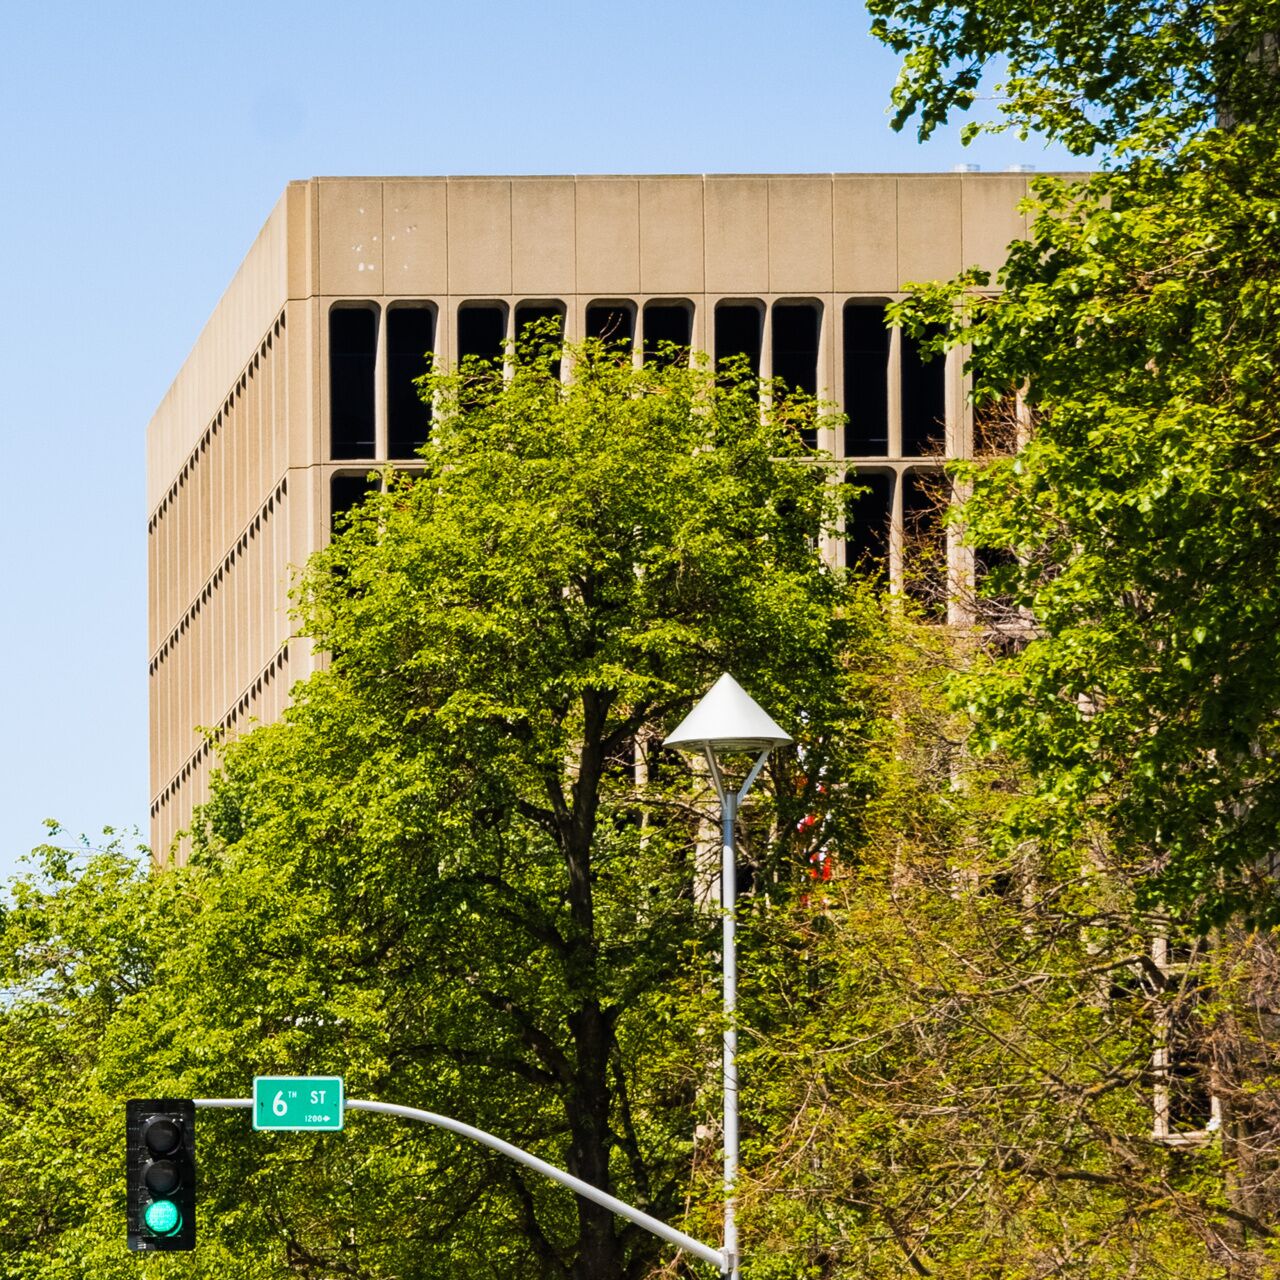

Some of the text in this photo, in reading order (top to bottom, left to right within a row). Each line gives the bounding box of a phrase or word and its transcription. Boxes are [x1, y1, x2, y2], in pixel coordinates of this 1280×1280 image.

[272, 1090, 326, 1117] 6TH ST
[305, 1115, 322, 1123] 1200
